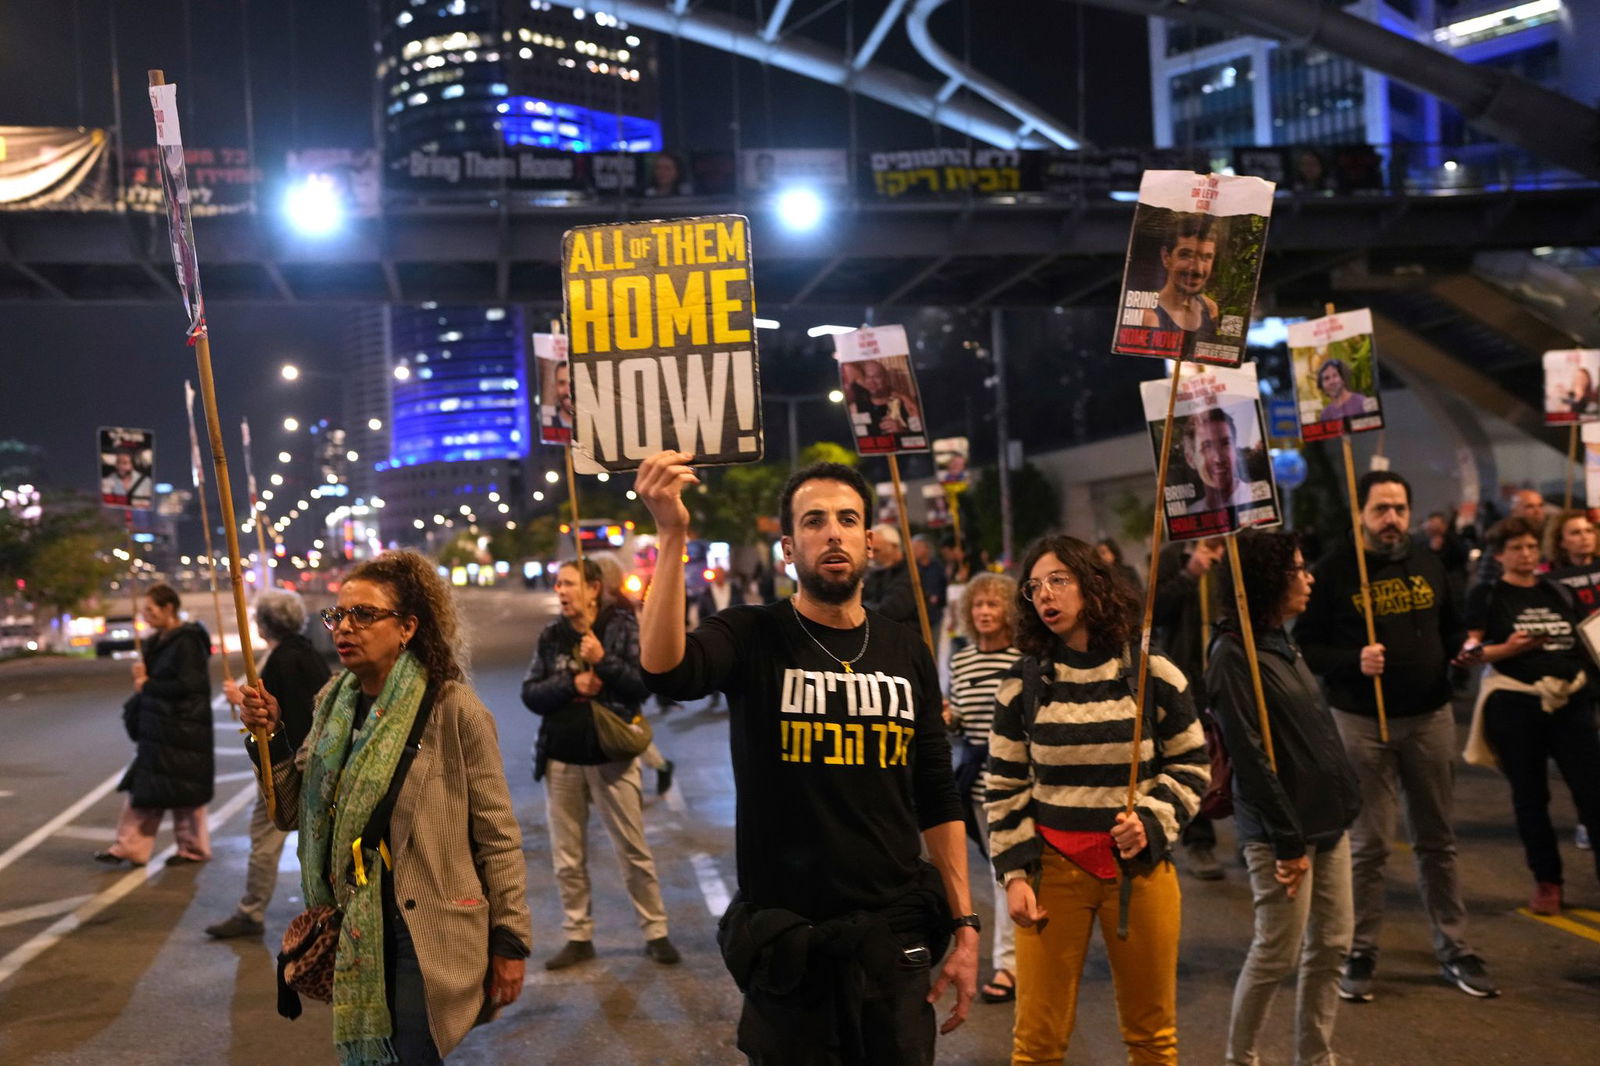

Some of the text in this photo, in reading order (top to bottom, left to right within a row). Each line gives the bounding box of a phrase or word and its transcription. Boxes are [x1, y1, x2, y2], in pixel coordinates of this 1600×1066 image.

[874, 168, 941, 197] ריק!
[945, 166, 1021, 192] הבית
[569, 220, 746, 274] ALL OF THEM
[568, 269, 750, 353] HOME
[1122, 308, 1144, 326] HIM
[1124, 291, 1159, 309] BRING
[573, 350, 757, 462] NOW!
[1164, 482, 1197, 502] BRING
[780, 668, 916, 722] בלעדיהם
[780, 721, 865, 765] הבית!
